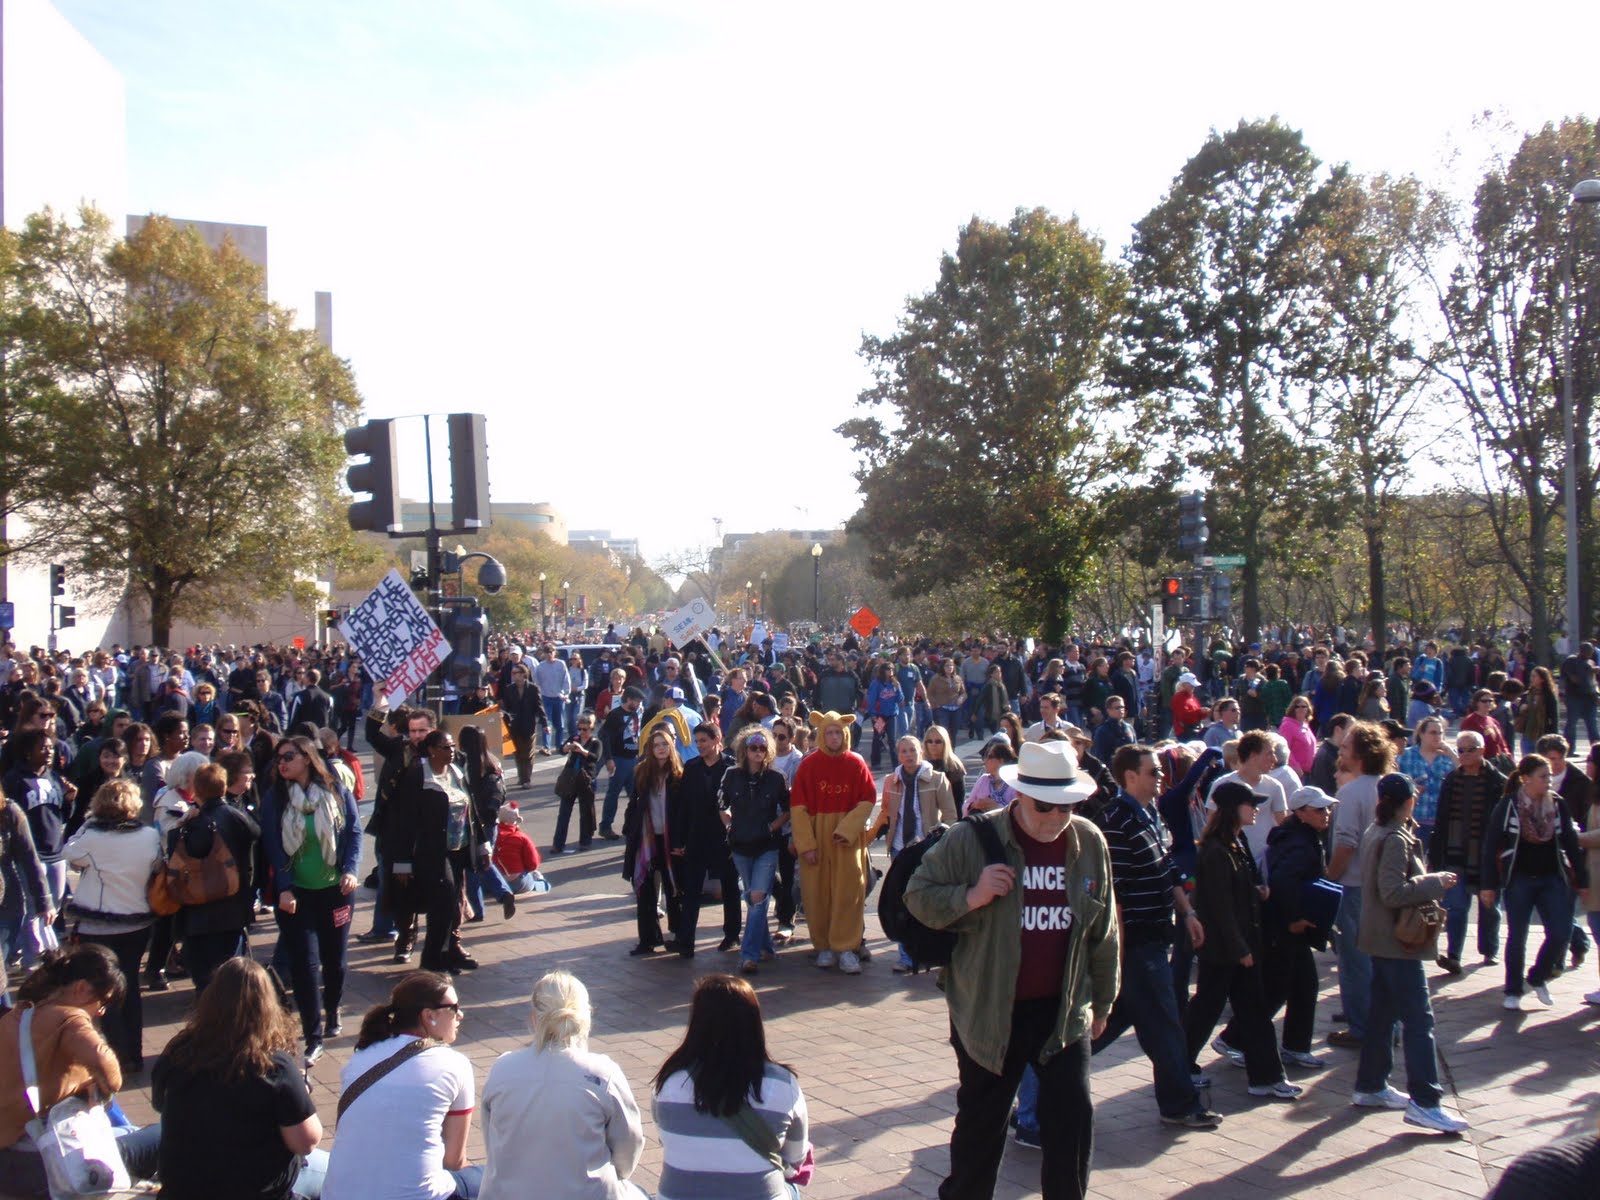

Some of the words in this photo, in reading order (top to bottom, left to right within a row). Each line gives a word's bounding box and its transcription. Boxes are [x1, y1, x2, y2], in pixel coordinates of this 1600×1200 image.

[347, 576, 395, 631] PEOPLE
[350, 615, 379, 647] WHO
[383, 583, 410, 616] ARE
[356, 594, 415, 660] DIFFERENT
[365, 633, 403, 672] FROM
[405, 606, 426, 632] ME
[373, 656, 397, 682] ARE
[394, 616, 433, 663] SCARY
[382, 662, 409, 697] KEEP
[410, 629, 443, 666] FEAR
[402, 651, 441, 696] ALIVE!
